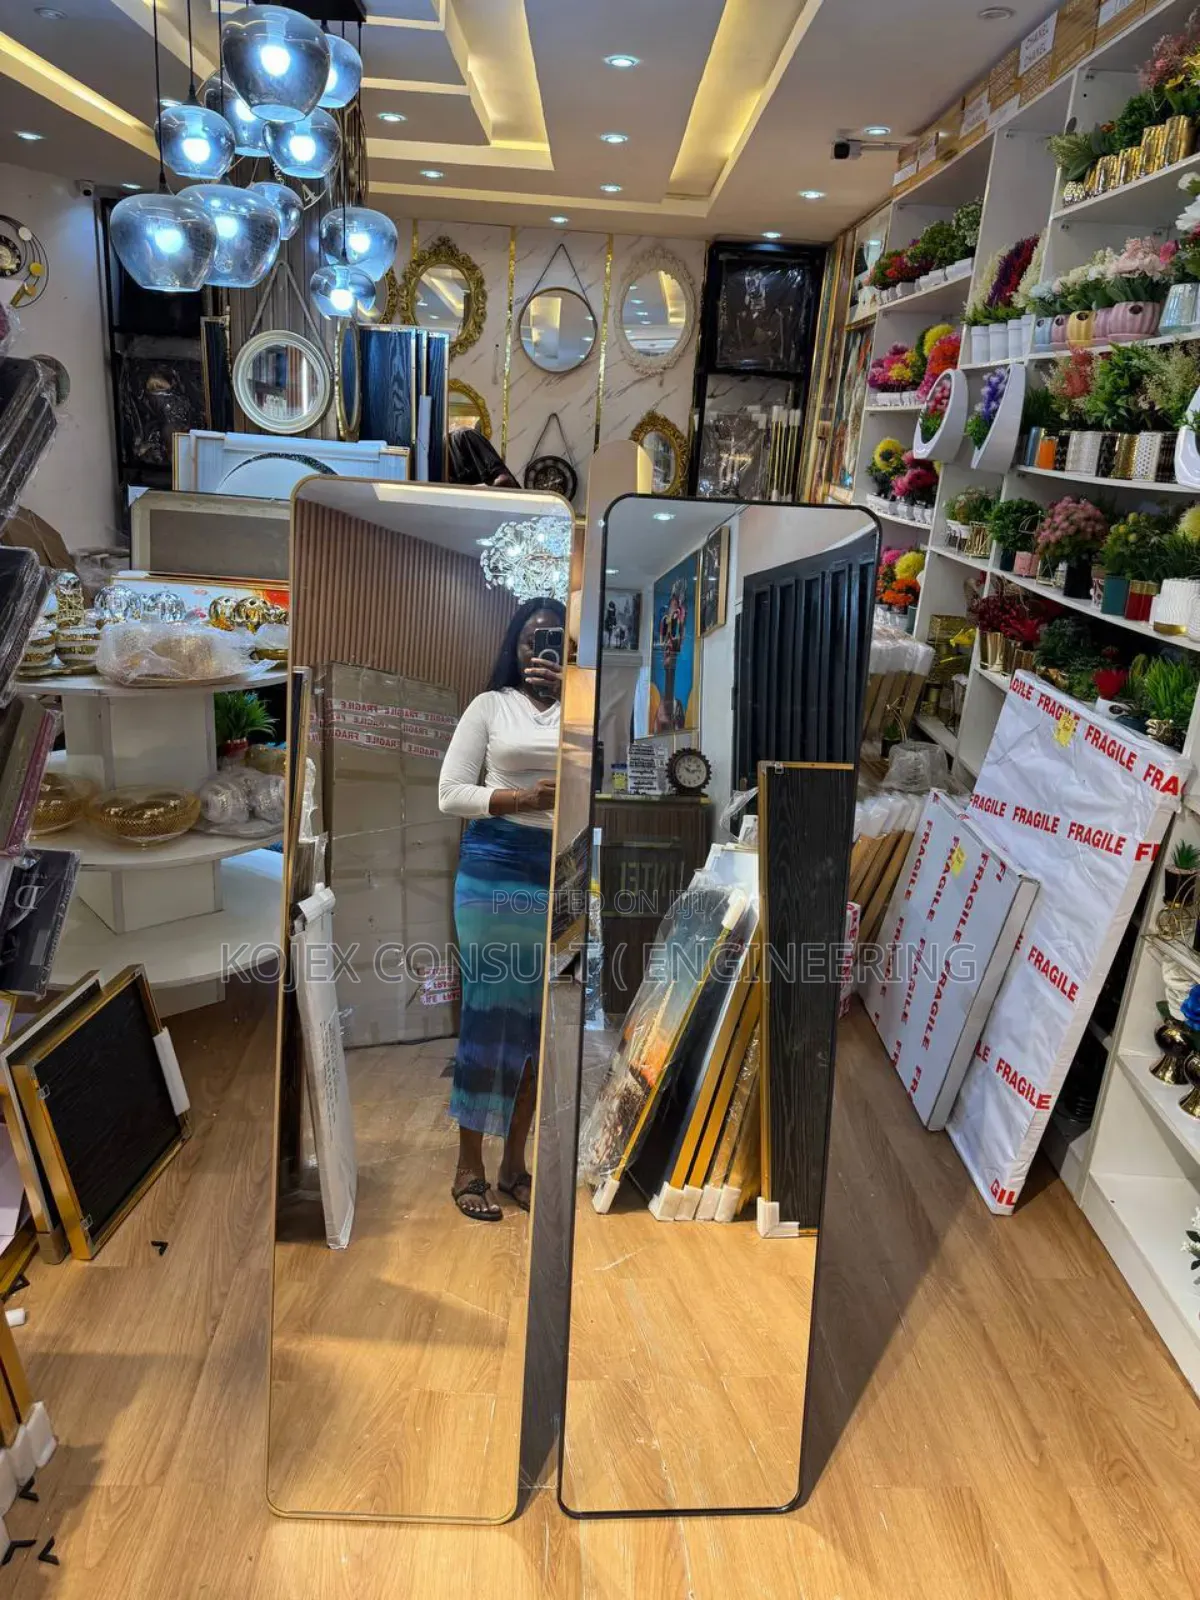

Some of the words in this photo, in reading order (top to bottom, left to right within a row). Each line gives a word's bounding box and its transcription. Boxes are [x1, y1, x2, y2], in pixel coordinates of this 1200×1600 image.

[1036, 692, 1080, 732] FRAG
[1084, 724, 1137, 772] FRAGILE
[1142, 763, 1186, 796] FRA
[904, 820, 933, 901] FRAGILE
[1012, 806, 1060, 834] FRAGILE
[1067, 822, 1126, 856] FRAGILE
[952, 852, 990, 943] FRAGILE
[921, 959, 951, 1051] FRAGILE
[1028, 944, 1080, 1003] FRAGILE
[995, 1058, 1052, 1111] FRAGILE
